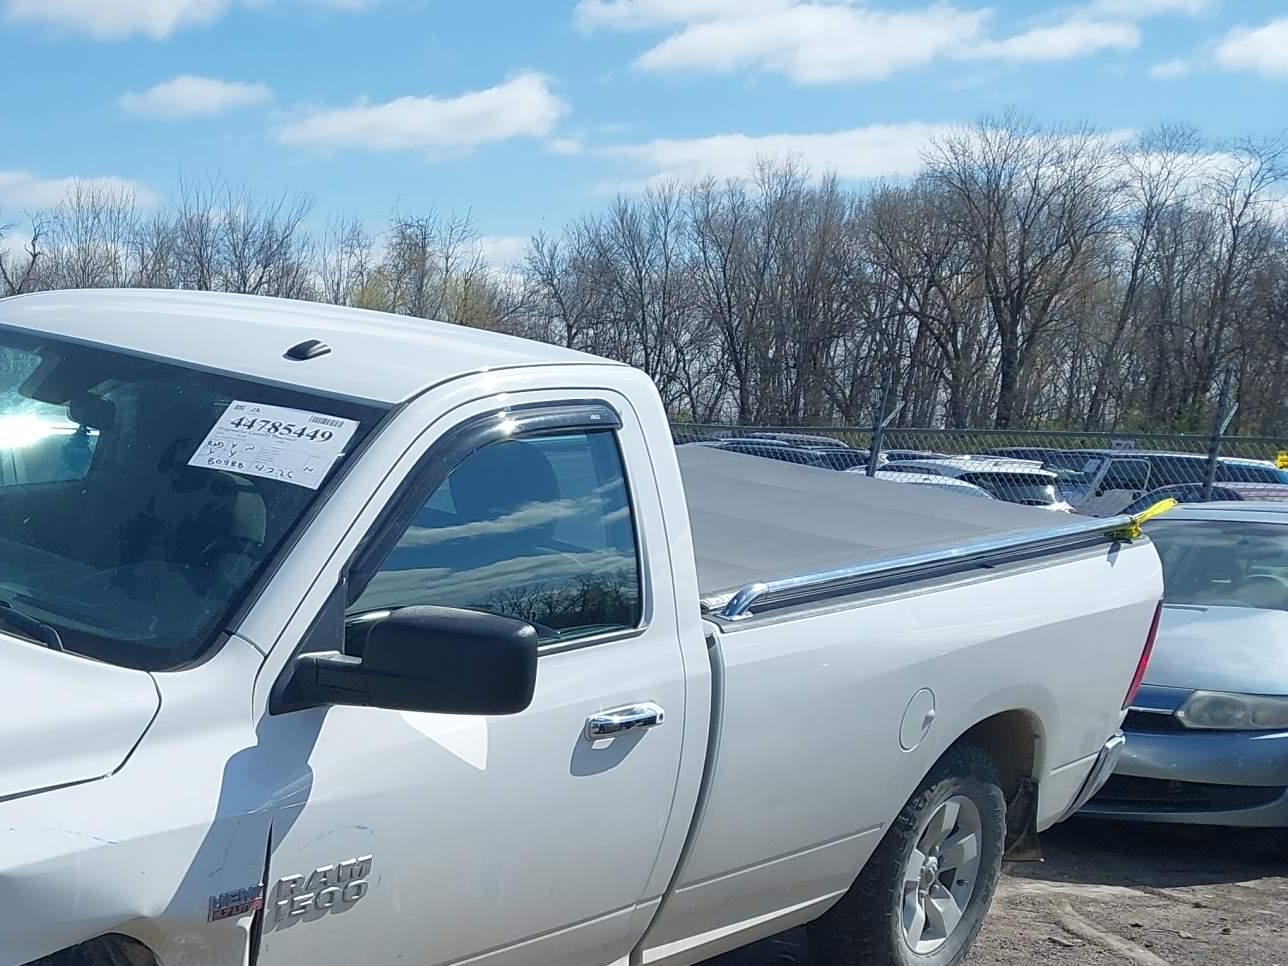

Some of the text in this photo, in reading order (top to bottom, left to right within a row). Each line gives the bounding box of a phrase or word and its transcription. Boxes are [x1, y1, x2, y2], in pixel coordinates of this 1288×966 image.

[230, 416, 334, 443] 44785449
[277, 854, 372, 898] RAM
[274, 880, 368, 922] 1500
